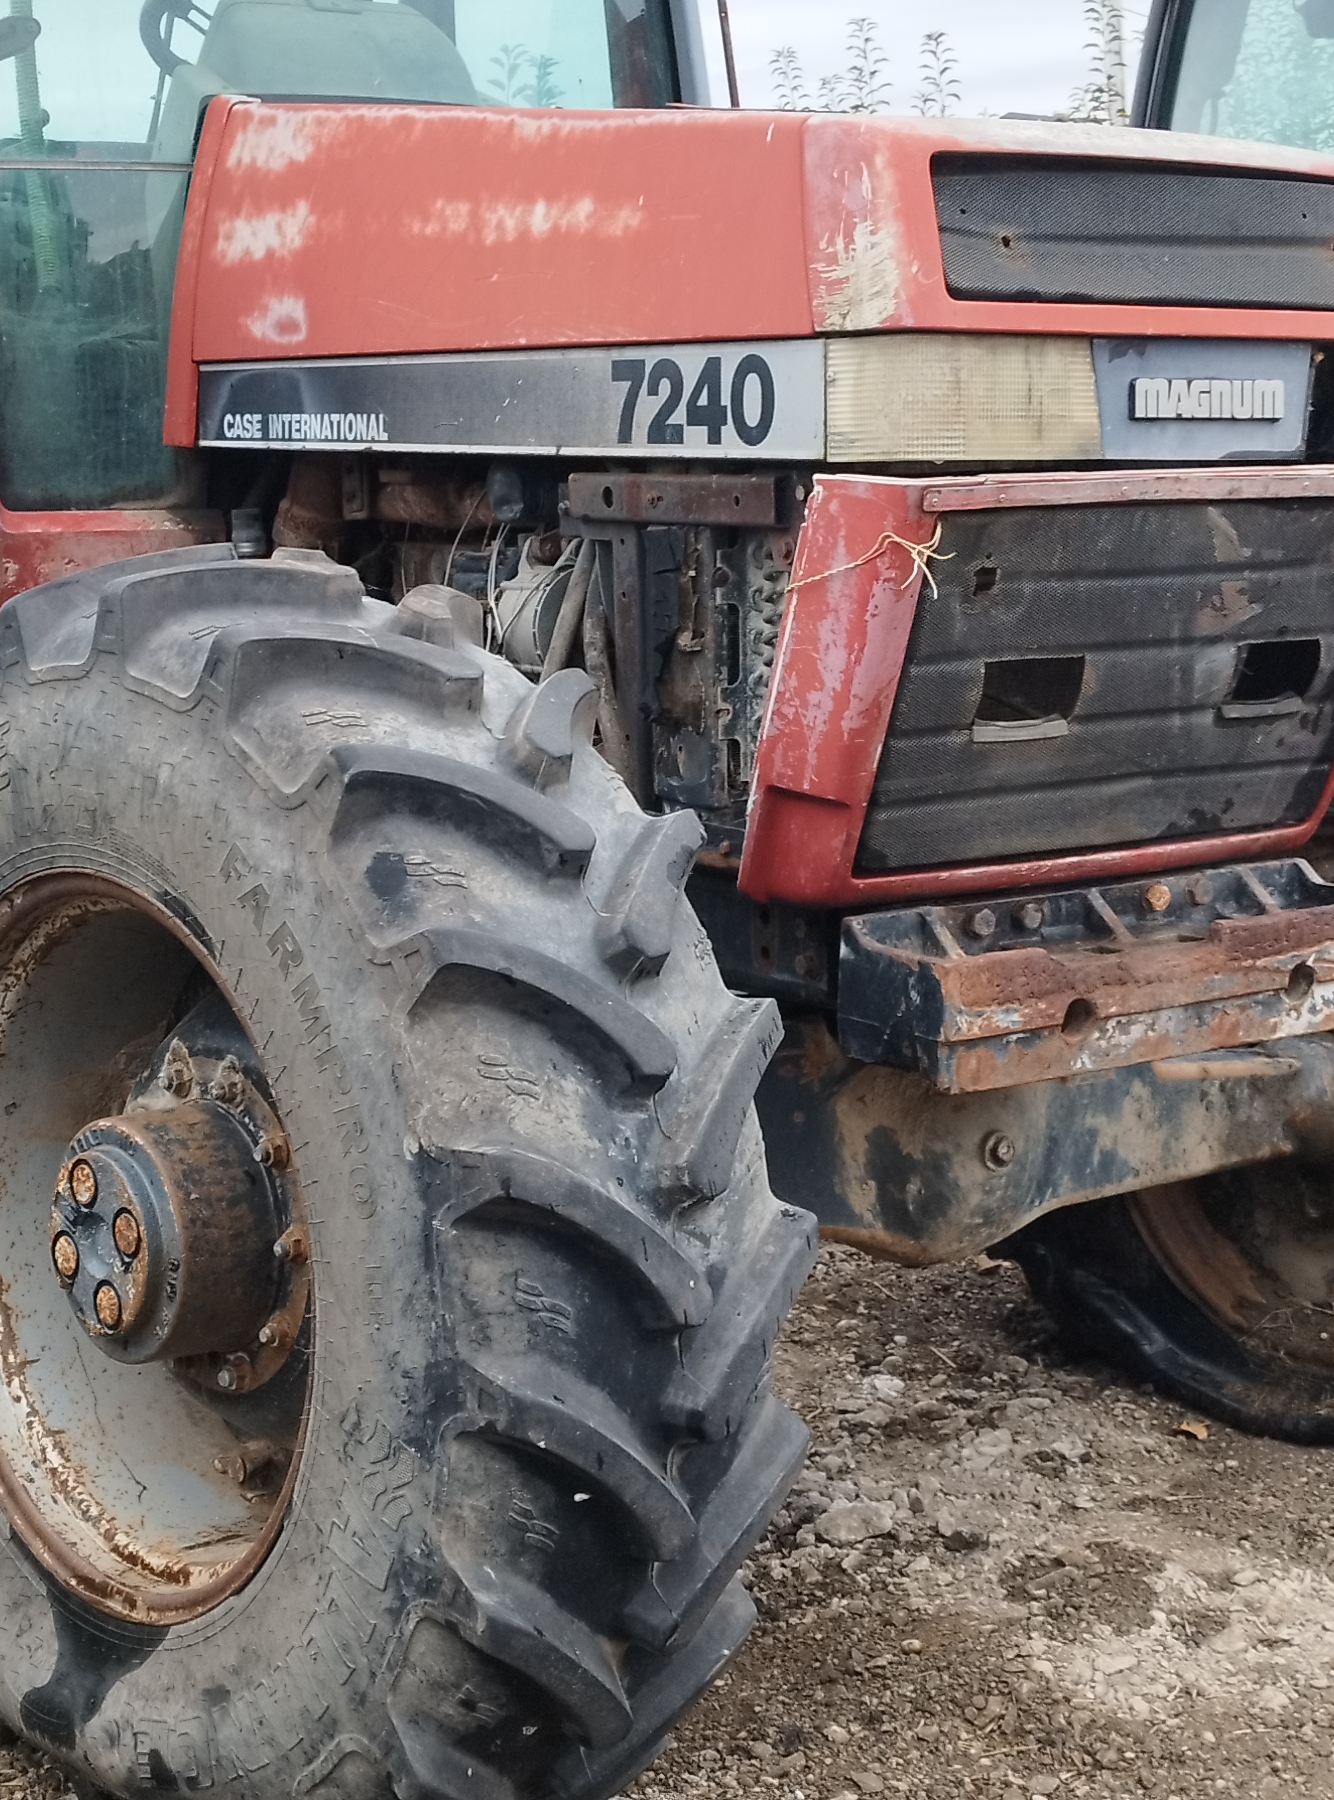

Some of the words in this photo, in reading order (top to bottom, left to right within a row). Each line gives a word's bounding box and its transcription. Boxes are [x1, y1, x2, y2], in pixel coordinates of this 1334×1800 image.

[223, 413, 263, 439] CASE
[268, 413, 389, 441] INTERNATIONAL
[611, 353, 775, 447] 7240
[1133, 377, 1284, 419] MAGNUM
[218, 842, 378, 1220] FARMPRO
